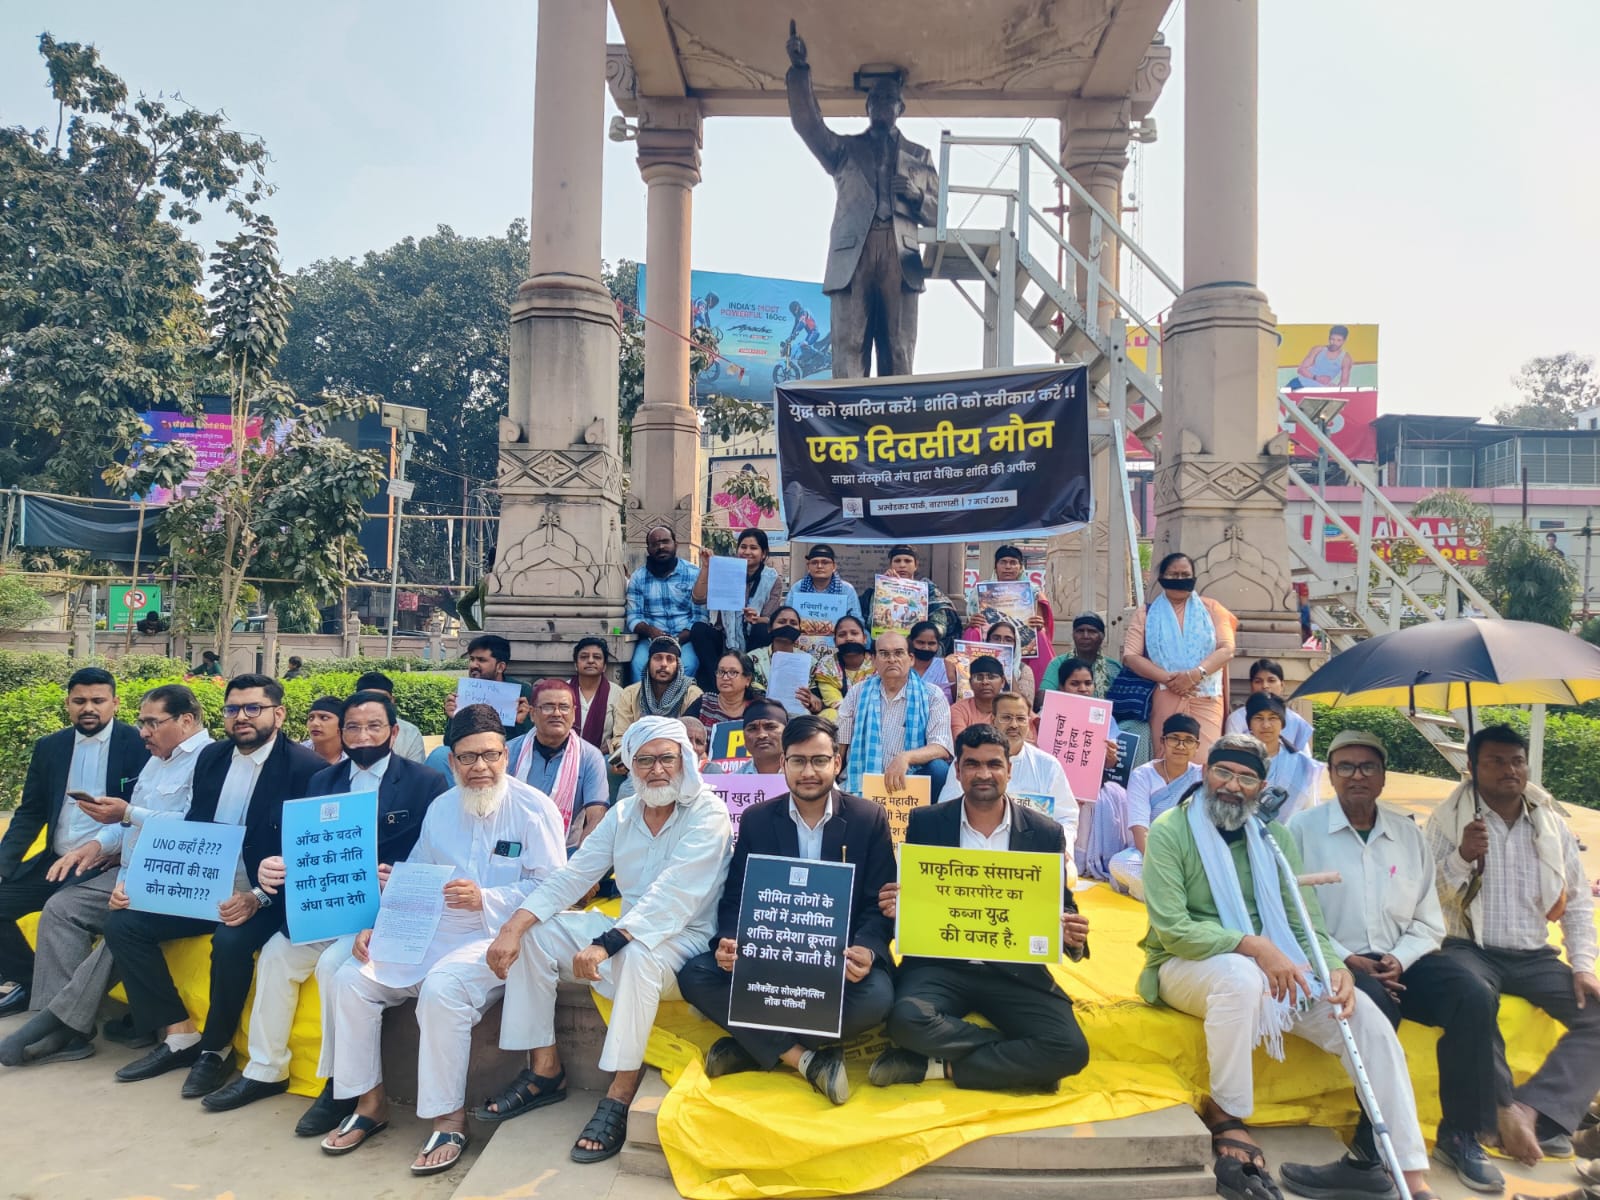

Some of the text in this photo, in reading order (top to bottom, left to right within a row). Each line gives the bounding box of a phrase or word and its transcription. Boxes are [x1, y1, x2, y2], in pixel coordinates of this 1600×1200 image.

[728, 301, 756, 311] INDIA'S
[788, 403, 815, 422] युद्ध
[816, 401, 836, 417] को
[838, 398, 886, 420] ख़ारिज
[887, 396, 917, 414] करें!
[924, 392, 958, 412] शांति
[960, 391, 981, 409] को
[983, 388, 1035, 407] स्वीकार
[1038, 384, 1063, 401] करें
[805, 413, 1055, 463] एक दिवसीय मौन
[830, 460, 1037, 486] साझा संस्कृति मंच द्वारा वैश्विक शांति की अपील
[928, 497, 959, 508] वाराणसी
[1063, 728, 1080, 764] की हत्या
[1080, 729, 1095, 767] बन्द करो
[731, 792, 752, 807] खुद
[889, 794, 919, 807] महावीर
[152, 837, 222, 855] UNO कहाँ है???
[295, 825, 363, 846] आँख के बदले
[295, 846, 364, 868] आँख की नीति
[143, 858, 220, 880] मानवता की रक्षा
[294, 868, 367, 892] सारी दुनिया को
[918, 859, 1042, 882] प्राकृतिक संसाधनों
[145, 879, 210, 901] कौन करेगा???
[324, 896, 344, 908] बना
[346, 889, 366, 906] देगी
[757, 887, 834, 909] सीमित लोगों के
[935, 883, 1023, 901] पर कारपोरेट का
[753, 906, 835, 928] हाथों में असीमित
[949, 907, 1010, 926] कब्जा युद्ध
[746, 924, 837, 950] शक्ति हमेशा क्रूरता
[939, 923, 1017, 949] की वजह है.
[741, 942, 758, 958] की
[759, 944, 780, 960] ओर
[782, 946, 793, 962] ले
[795, 950, 822, 966] जाती
[764, 995, 781, 1006] लोक
